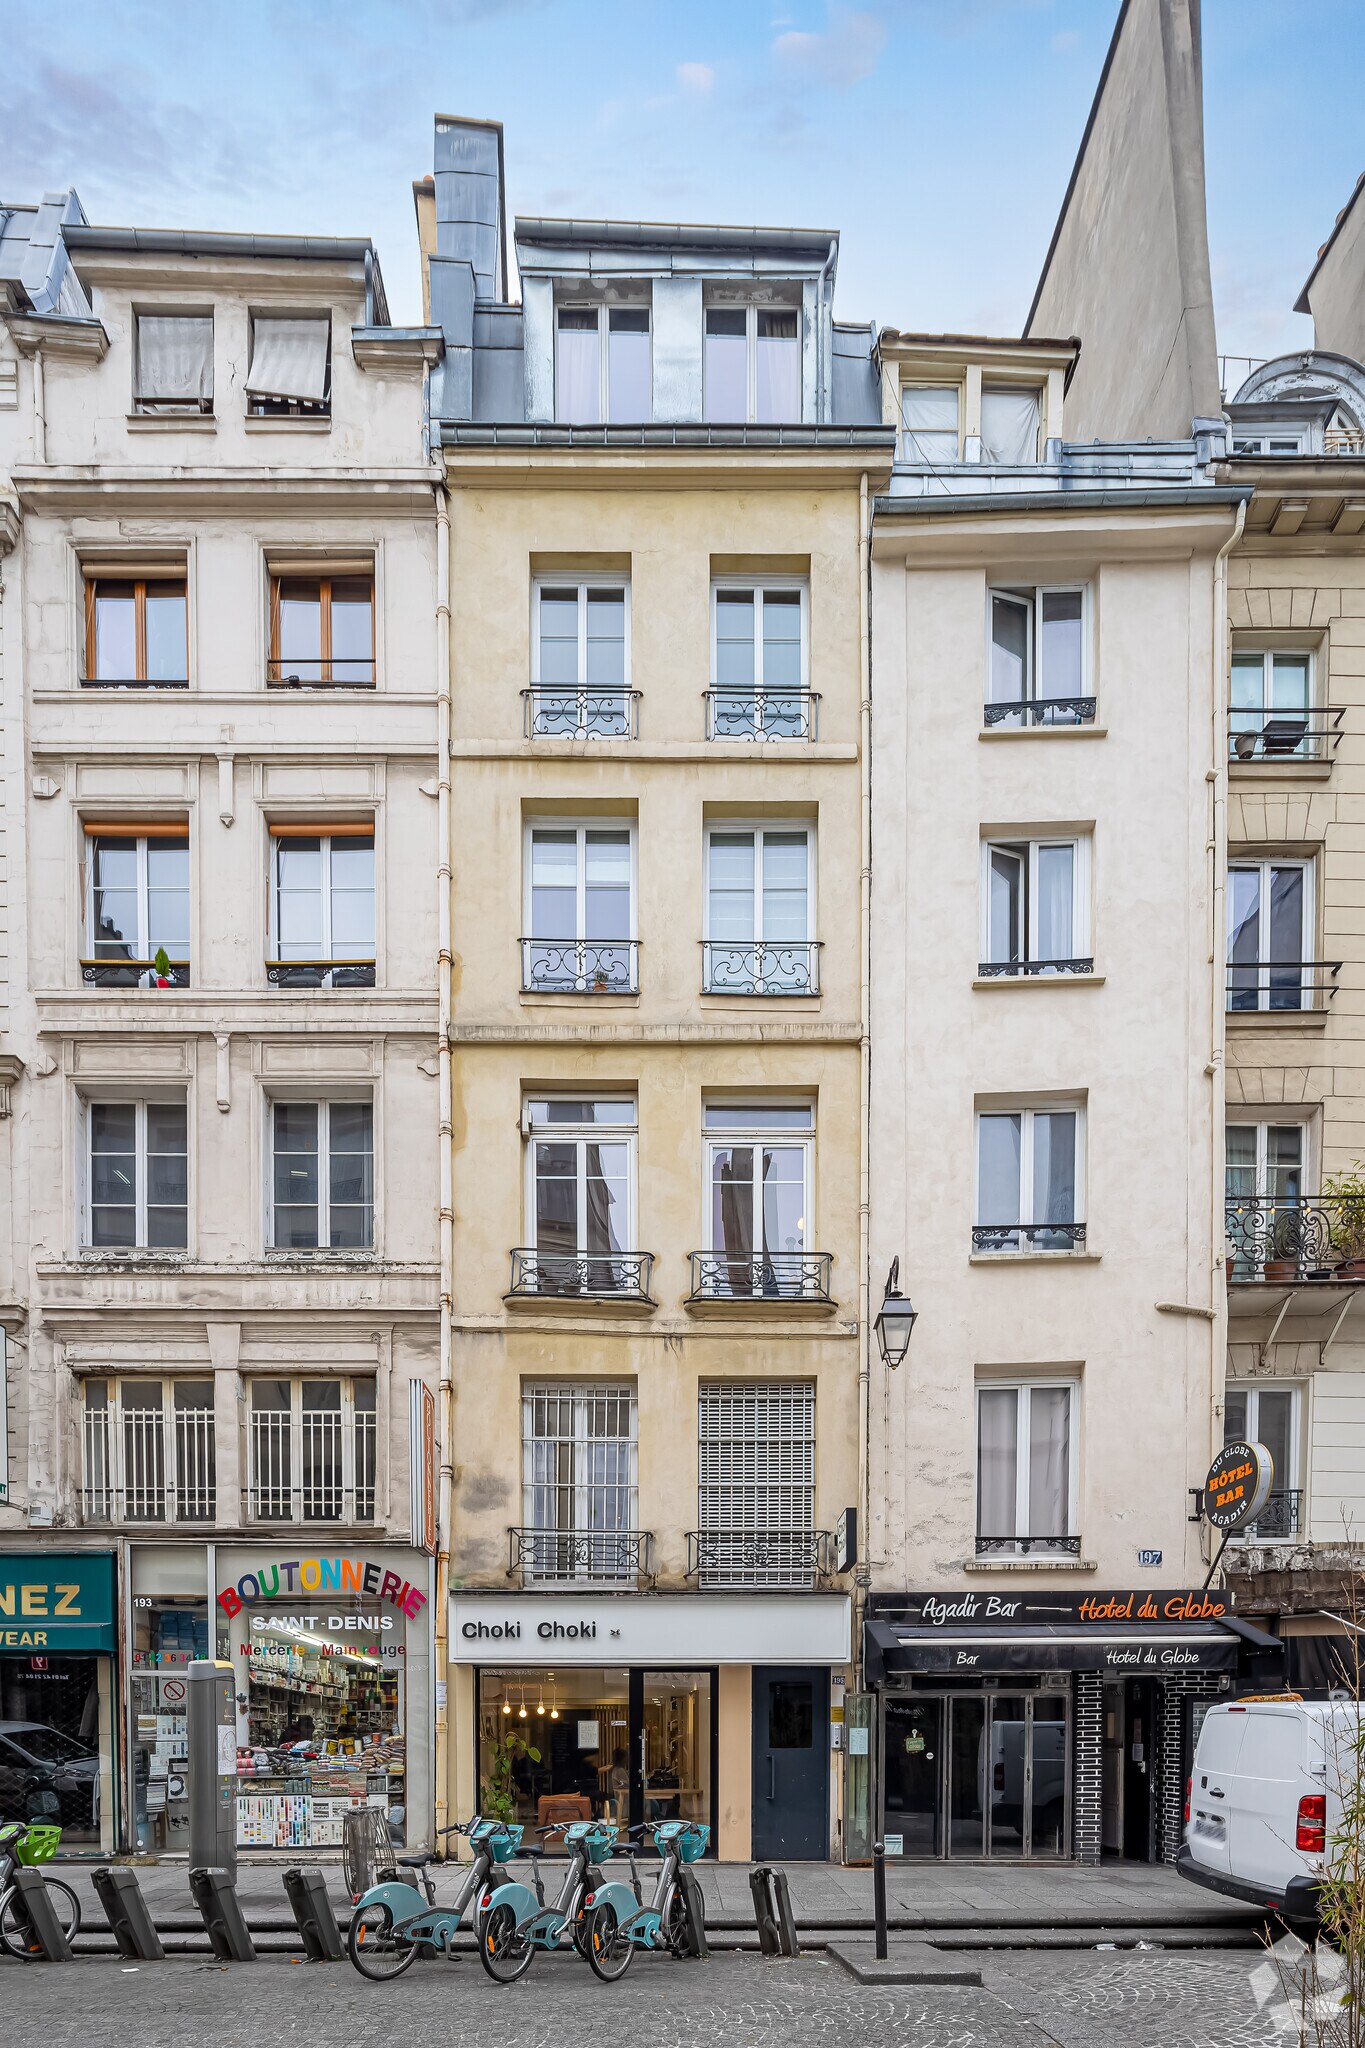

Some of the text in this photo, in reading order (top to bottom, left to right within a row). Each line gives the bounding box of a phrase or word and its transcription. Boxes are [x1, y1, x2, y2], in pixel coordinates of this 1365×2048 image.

[1212, 1446, 1250, 1473] DU GLOBE
[1208, 1462, 1253, 1492] HÔTEL
[1216, 1486, 1244, 1508] BAR
[1211, 1500, 1248, 1525] AGADIR
[1140, 1551, 1161, 1564] 197
[217, 1558, 428, 1620] BOUTONNERIE
[134, 1598, 152, 1608] 193
[922, 1592, 1022, 1625] Agadir Bar
[1078, 1592, 1226, 1621] Hotel du Globe
[462, 1620, 596, 1638] Choki Choki
[0, 1631, 48, 1646] EAR
[164, 1654, 176, 1662] 36
[180, 1654, 192, 1662] 34
[240, 1643, 305, 1656] Mercerie
[322, 1643, 357, 1656] Main
[362, 1644, 406, 1659] rouge
[956, 1652, 980, 1666] Bar
[1106, 1648, 1200, 1665] Hotel du Globe
